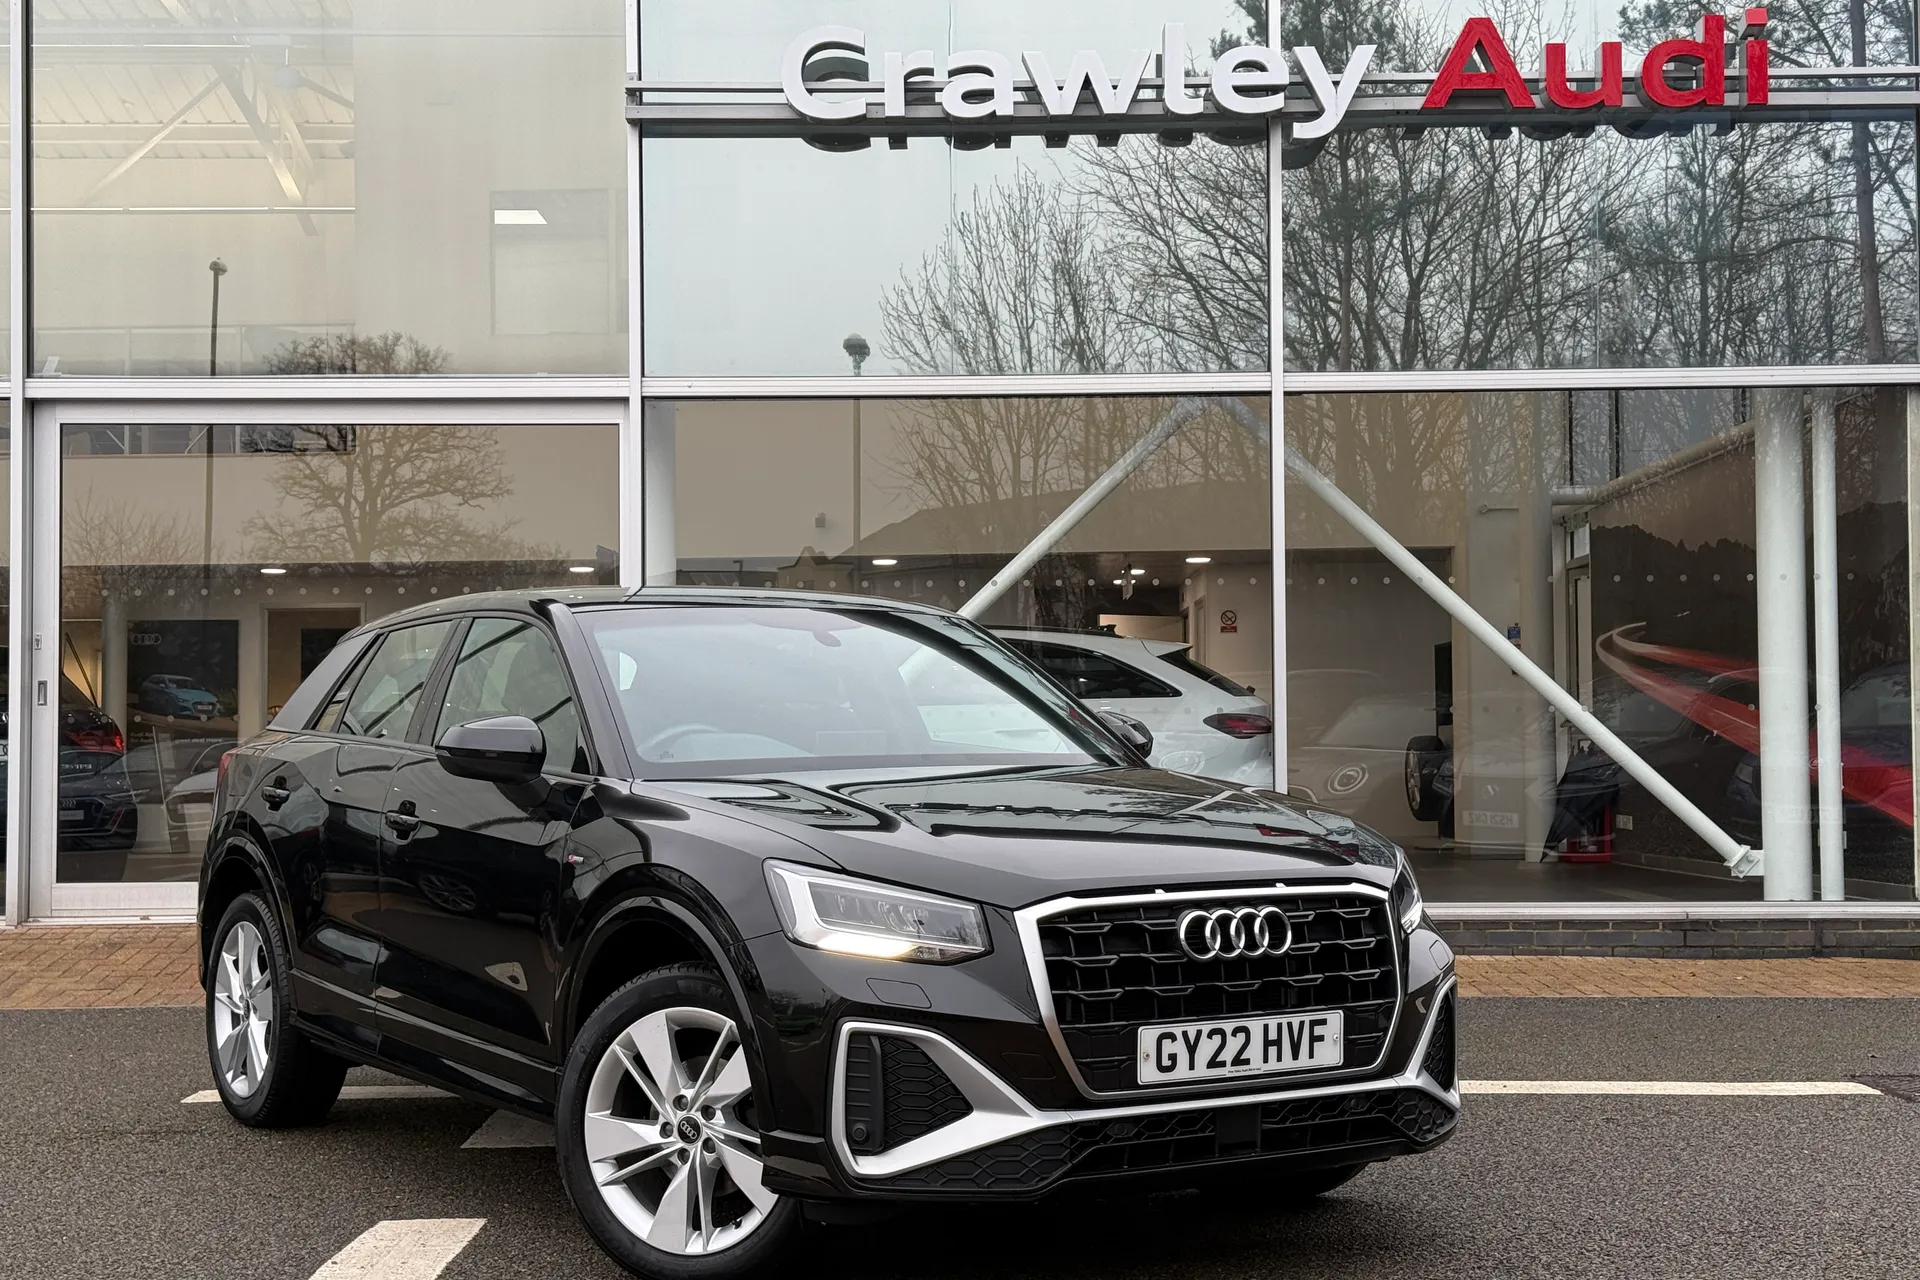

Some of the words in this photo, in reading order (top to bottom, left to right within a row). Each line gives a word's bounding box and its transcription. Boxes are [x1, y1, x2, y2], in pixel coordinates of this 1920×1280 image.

[781, 22, 1377, 140] Crawley
[1421, 7, 1769, 109] Audi
[1155, 1025, 1251, 1073] GY22
[1262, 1018, 1328, 1064] HVF
